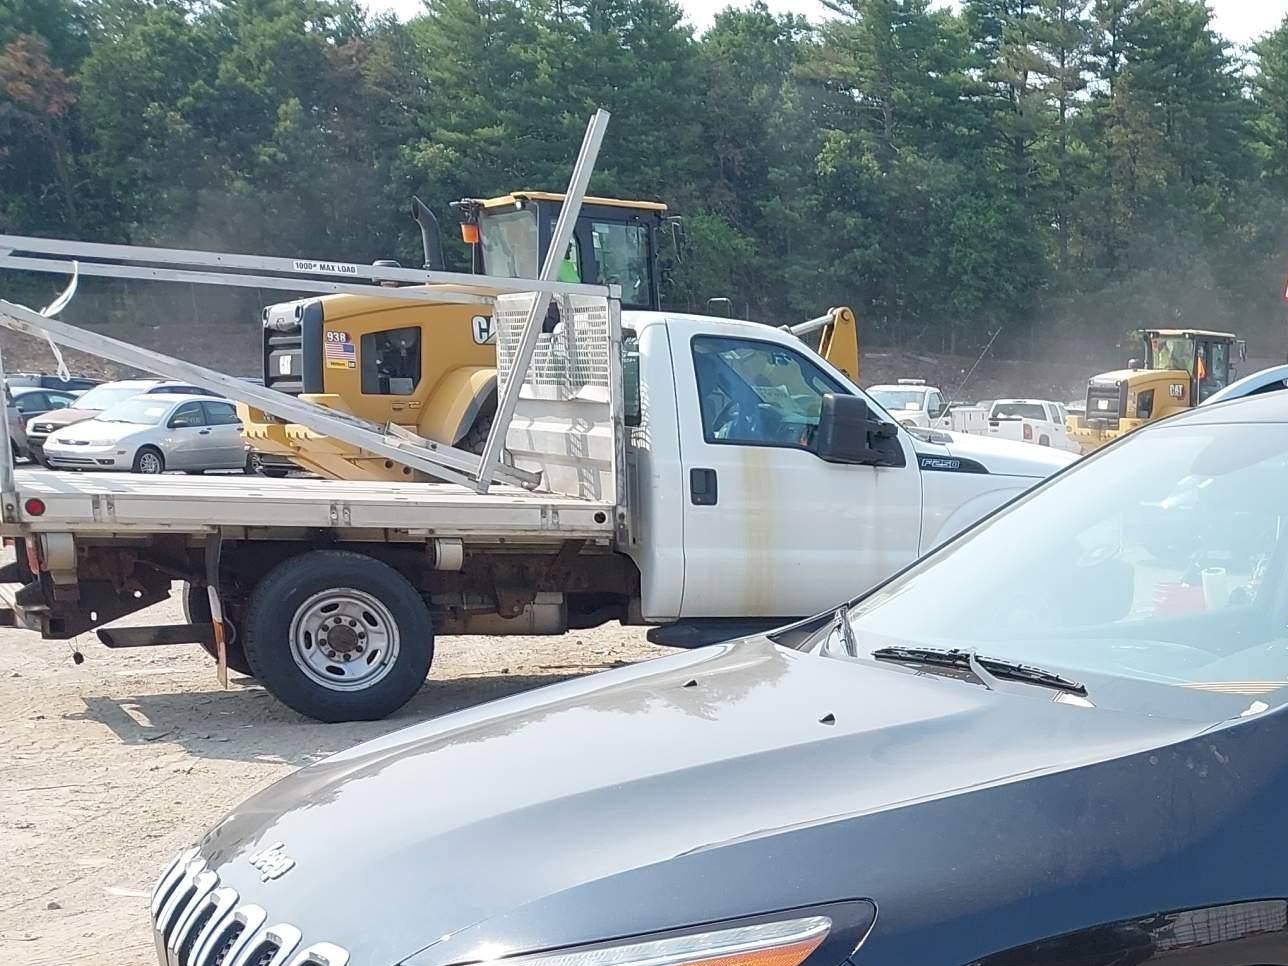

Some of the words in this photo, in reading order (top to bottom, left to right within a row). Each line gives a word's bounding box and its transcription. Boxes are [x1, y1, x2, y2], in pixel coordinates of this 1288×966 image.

[319, 263, 336, 272] MAX
[337, 265, 356, 273] LOAD
[327, 331, 346, 343] 938
[1169, 384, 1184, 397] CAT
